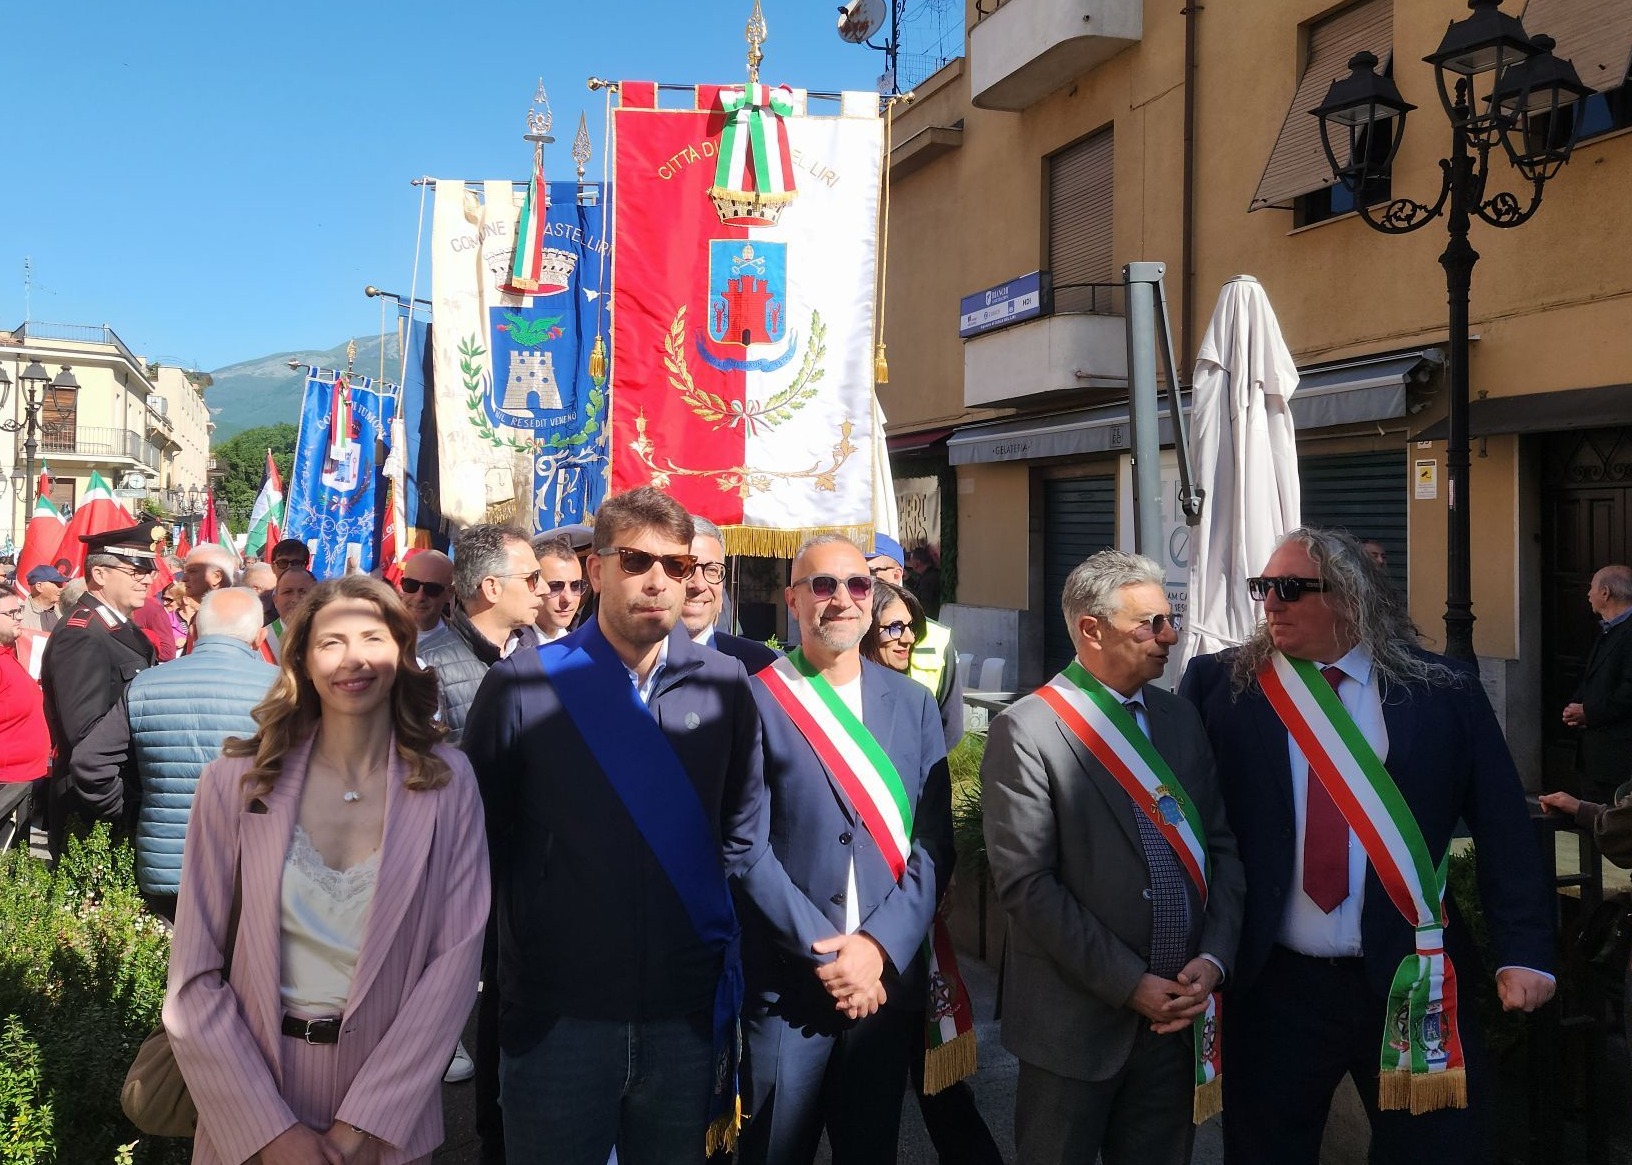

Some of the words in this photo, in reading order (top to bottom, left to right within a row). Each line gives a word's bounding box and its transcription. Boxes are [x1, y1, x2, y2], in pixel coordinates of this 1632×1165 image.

[702, 140, 719, 157] DI
[809, 160, 841, 188] LIRI
[450, 221, 507, 253] COMUNE
[544, 222, 612, 257] ASTELLIRI
[495, 410, 506, 423] NIL
[510, 417, 548, 428] RESEDIT
[550, 411, 577, 427] VENENO
